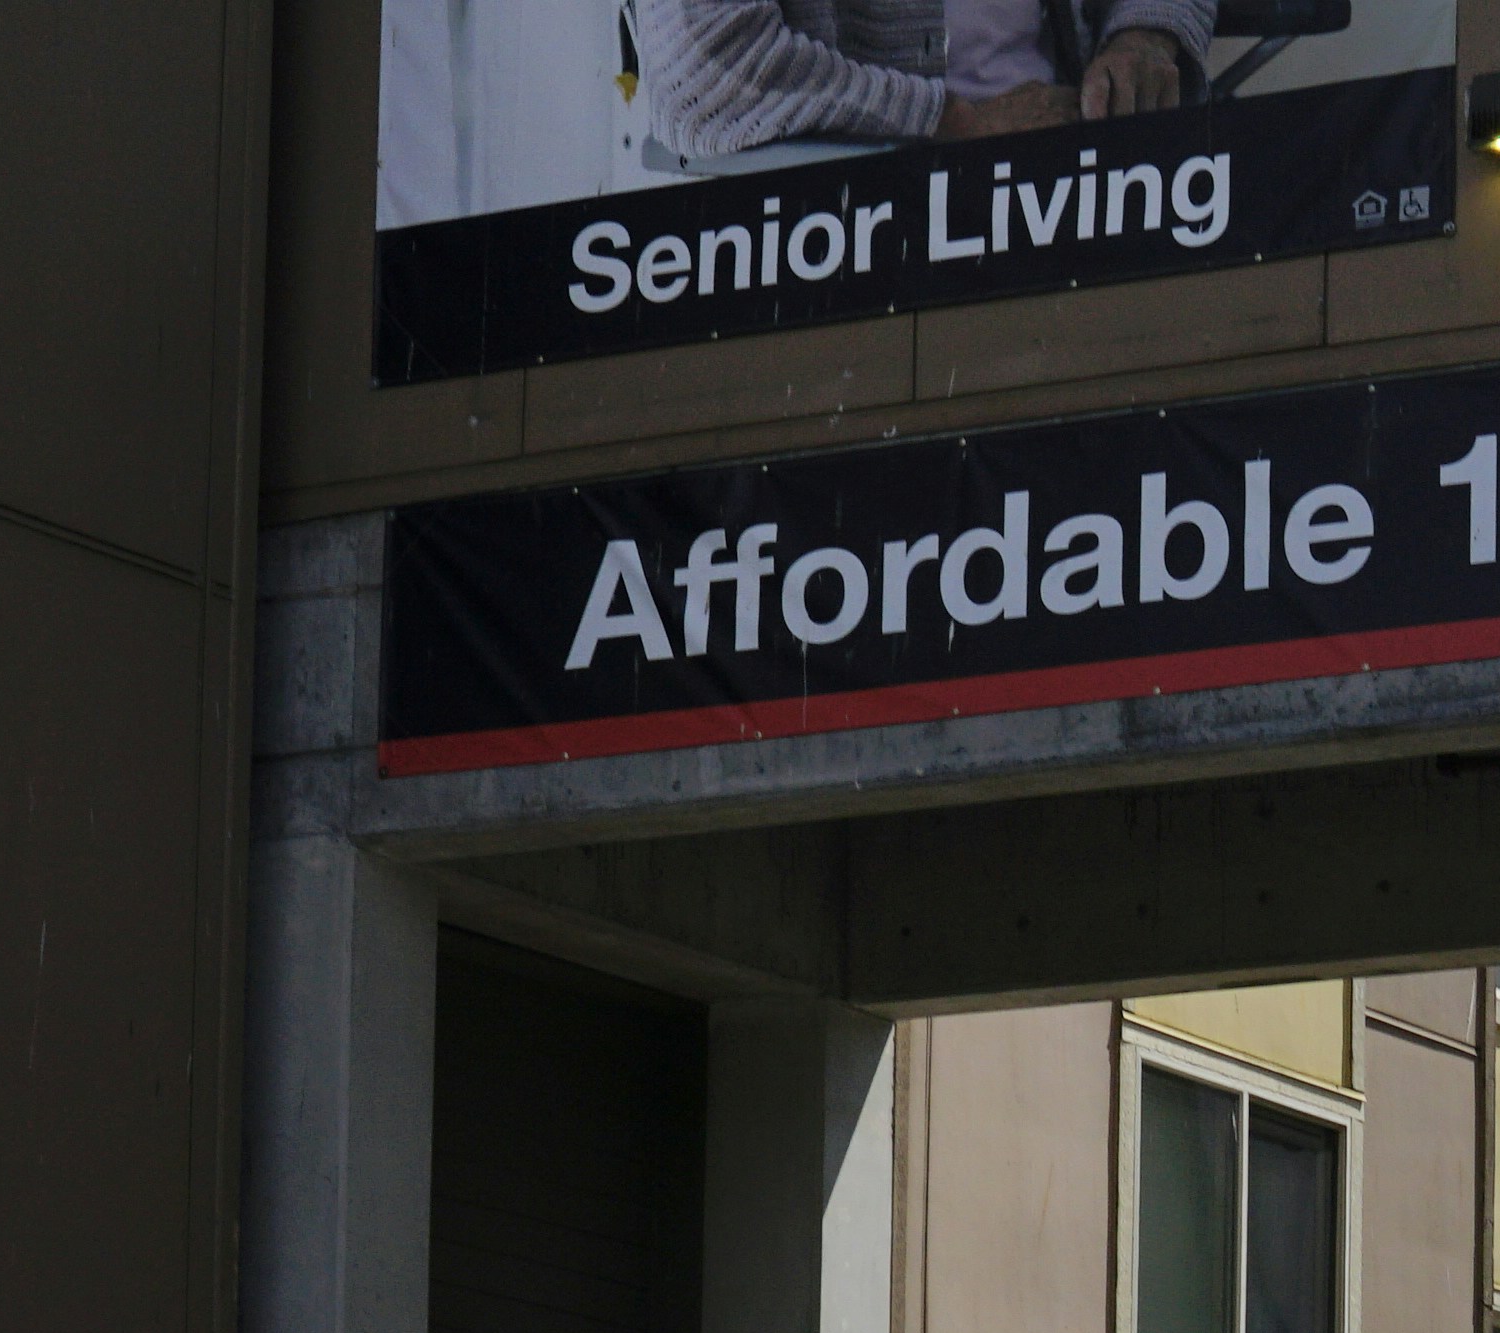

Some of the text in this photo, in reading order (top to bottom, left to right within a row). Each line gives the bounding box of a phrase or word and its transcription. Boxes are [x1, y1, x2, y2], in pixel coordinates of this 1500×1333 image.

[569, 149, 1230, 312] Senior Living
[565, 459, 1374, 669] Affordable
